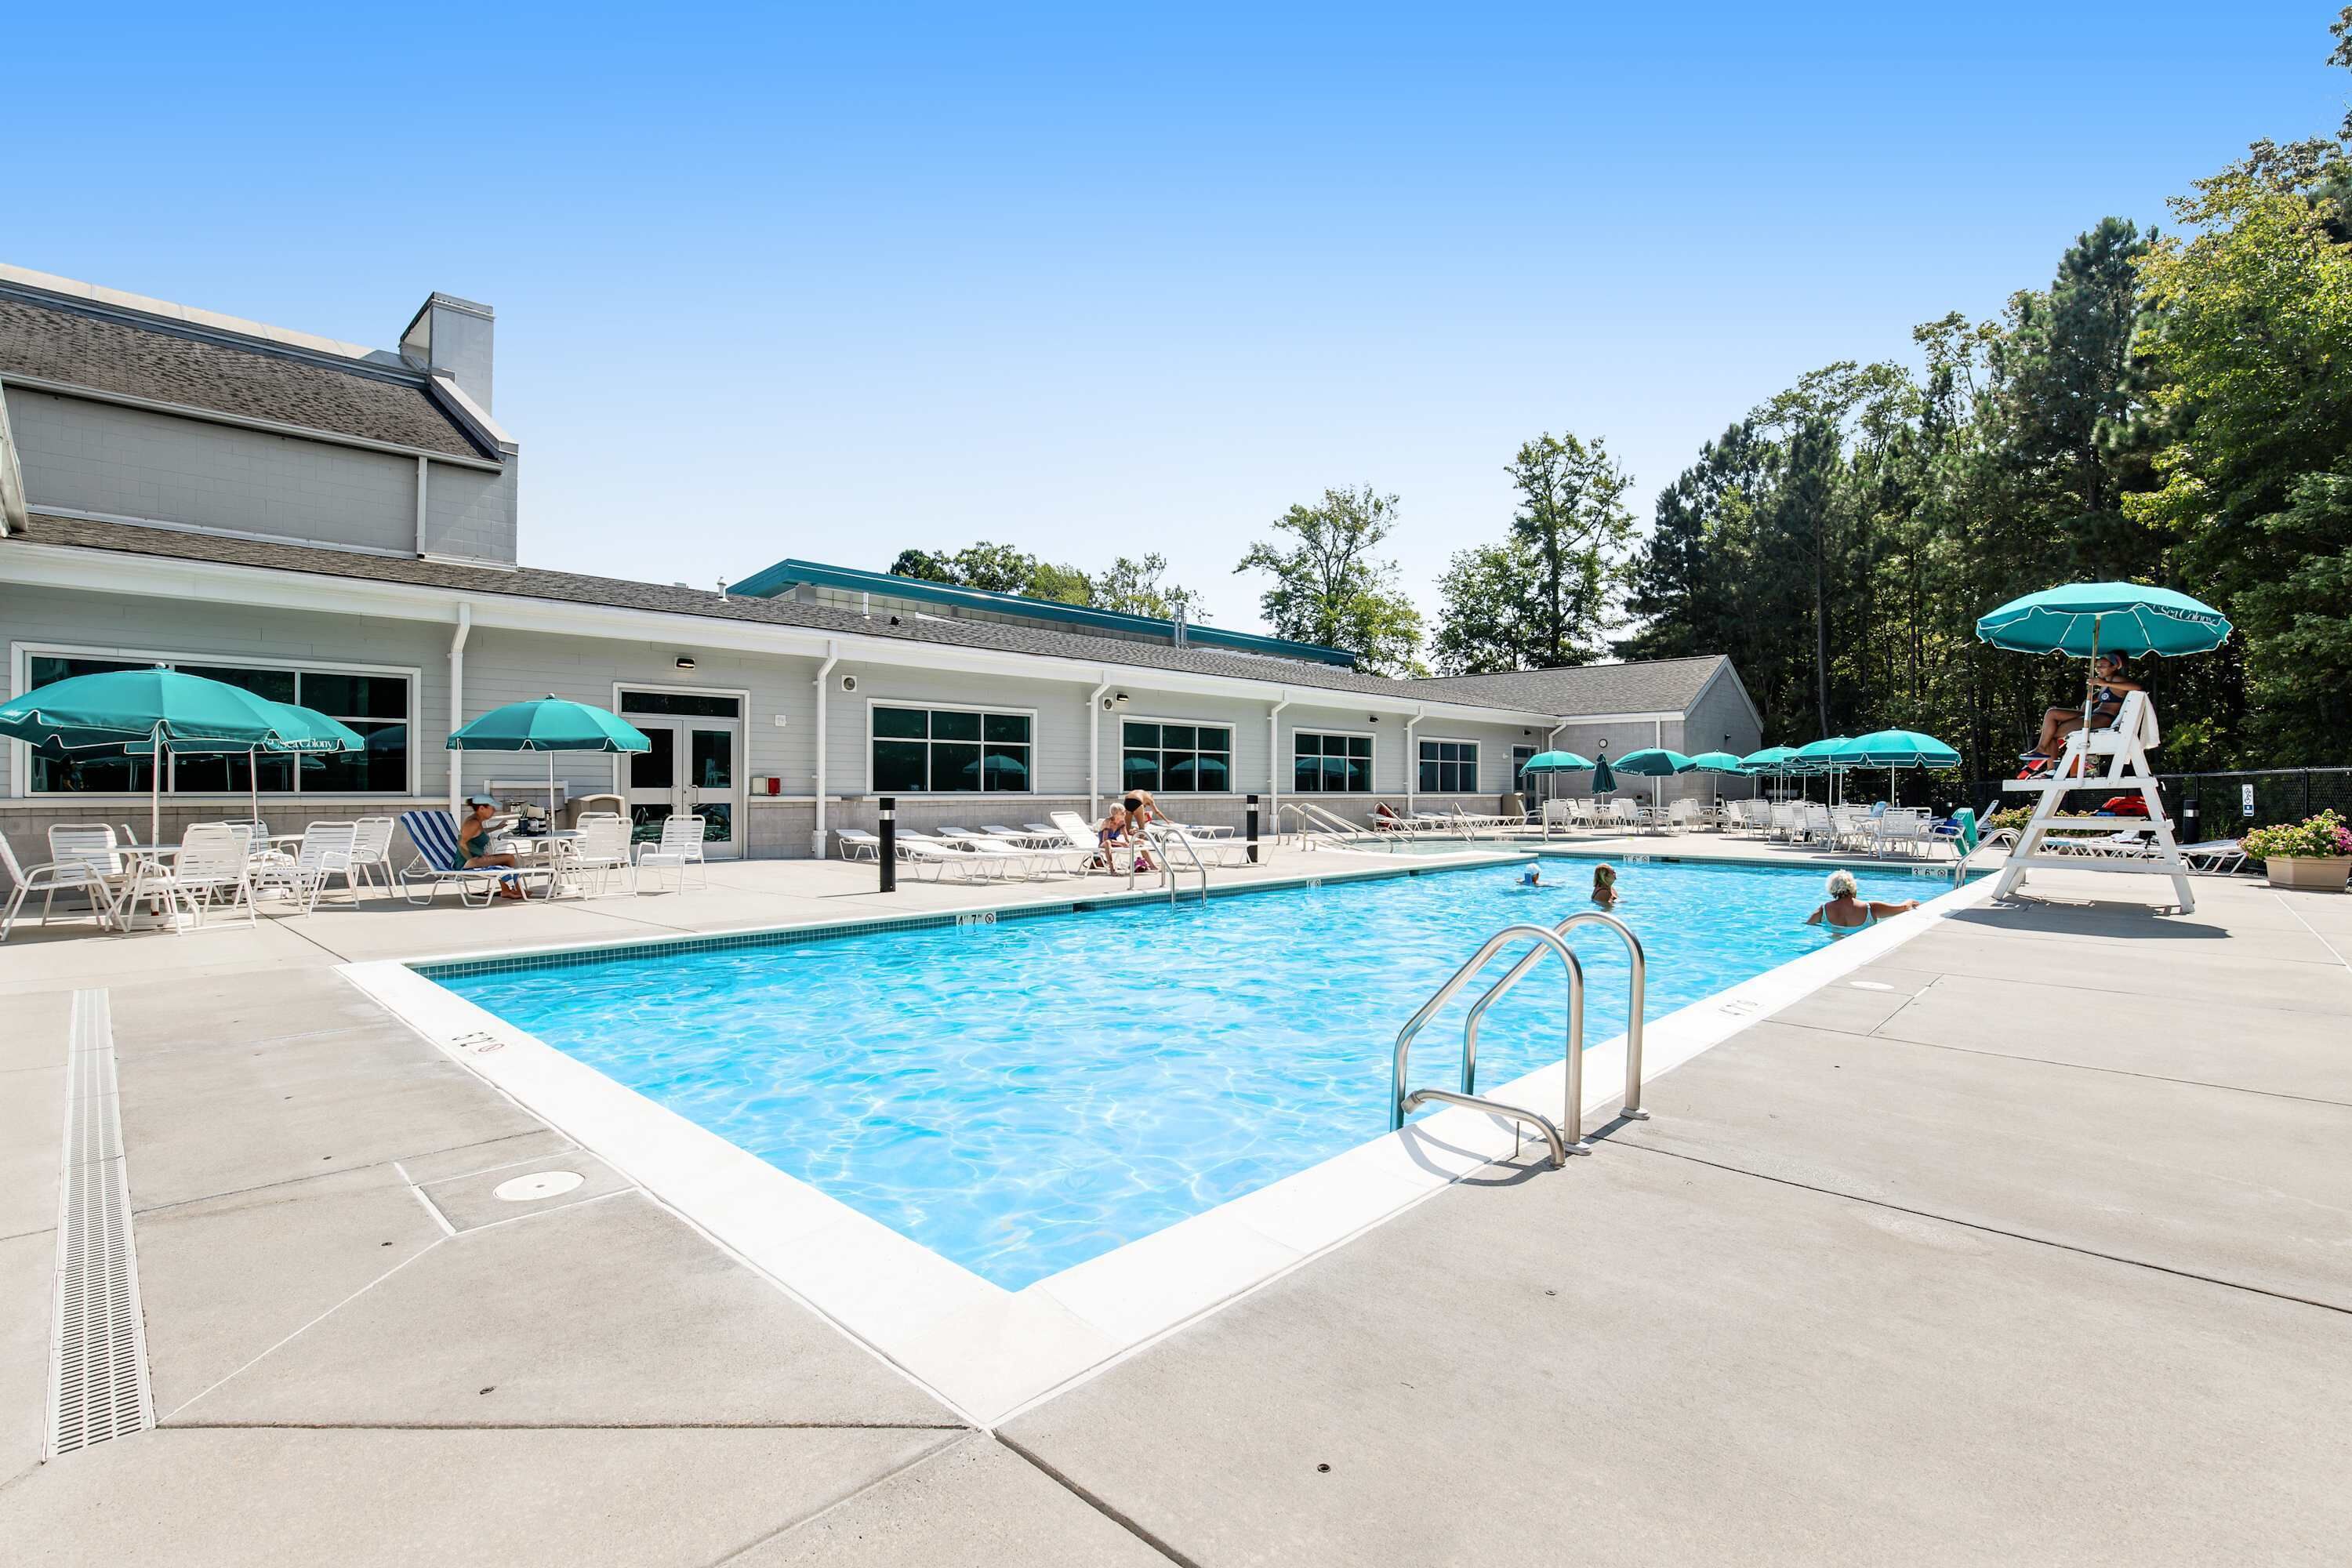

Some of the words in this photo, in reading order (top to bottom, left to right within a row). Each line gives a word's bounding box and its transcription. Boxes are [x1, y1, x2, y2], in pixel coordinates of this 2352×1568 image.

[2161, 604, 2179, 619] Sea
[2180, 608, 2216, 624] Colony
[299, 739, 333, 750] Colony
